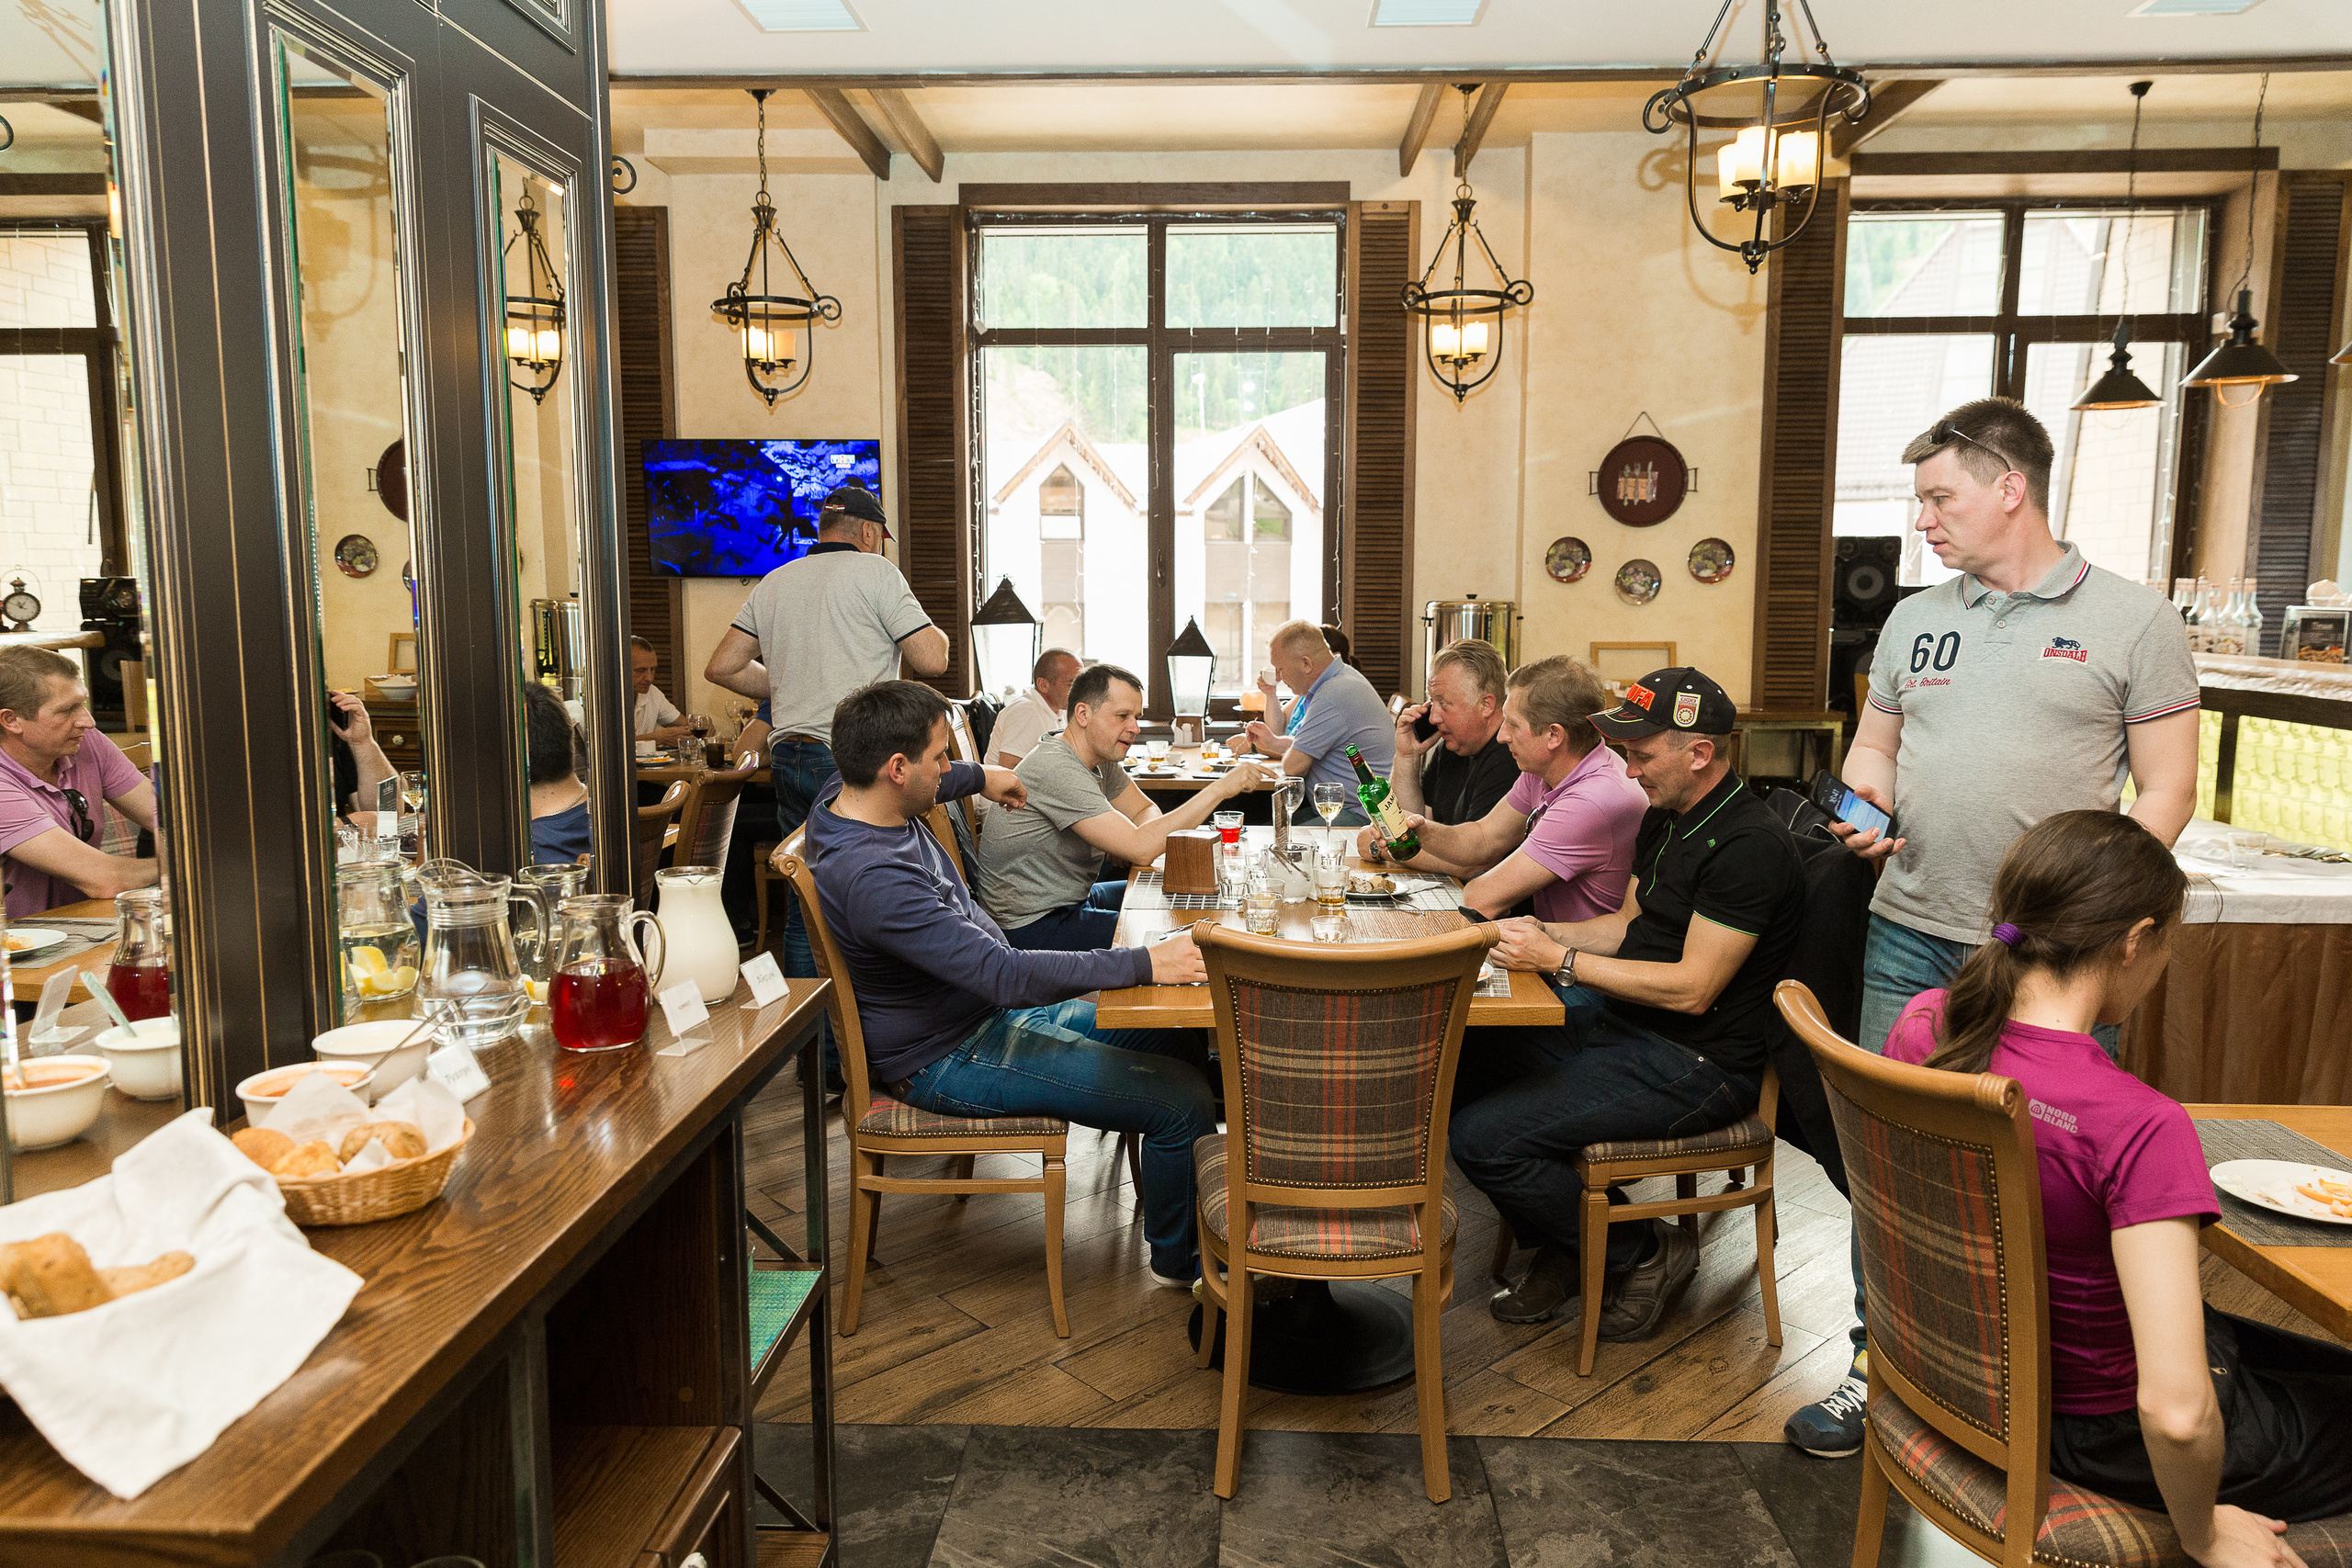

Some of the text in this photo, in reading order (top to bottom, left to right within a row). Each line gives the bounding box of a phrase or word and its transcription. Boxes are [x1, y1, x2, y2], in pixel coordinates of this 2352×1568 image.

[1910, 630, 1962, 674] 60
[1919, 676, 1951, 687] Britain
[1626, 682, 1657, 712] UFA
[2043, 1112, 2079, 1134] BLANC
[2046, 1105, 2077, 1124] NORD
